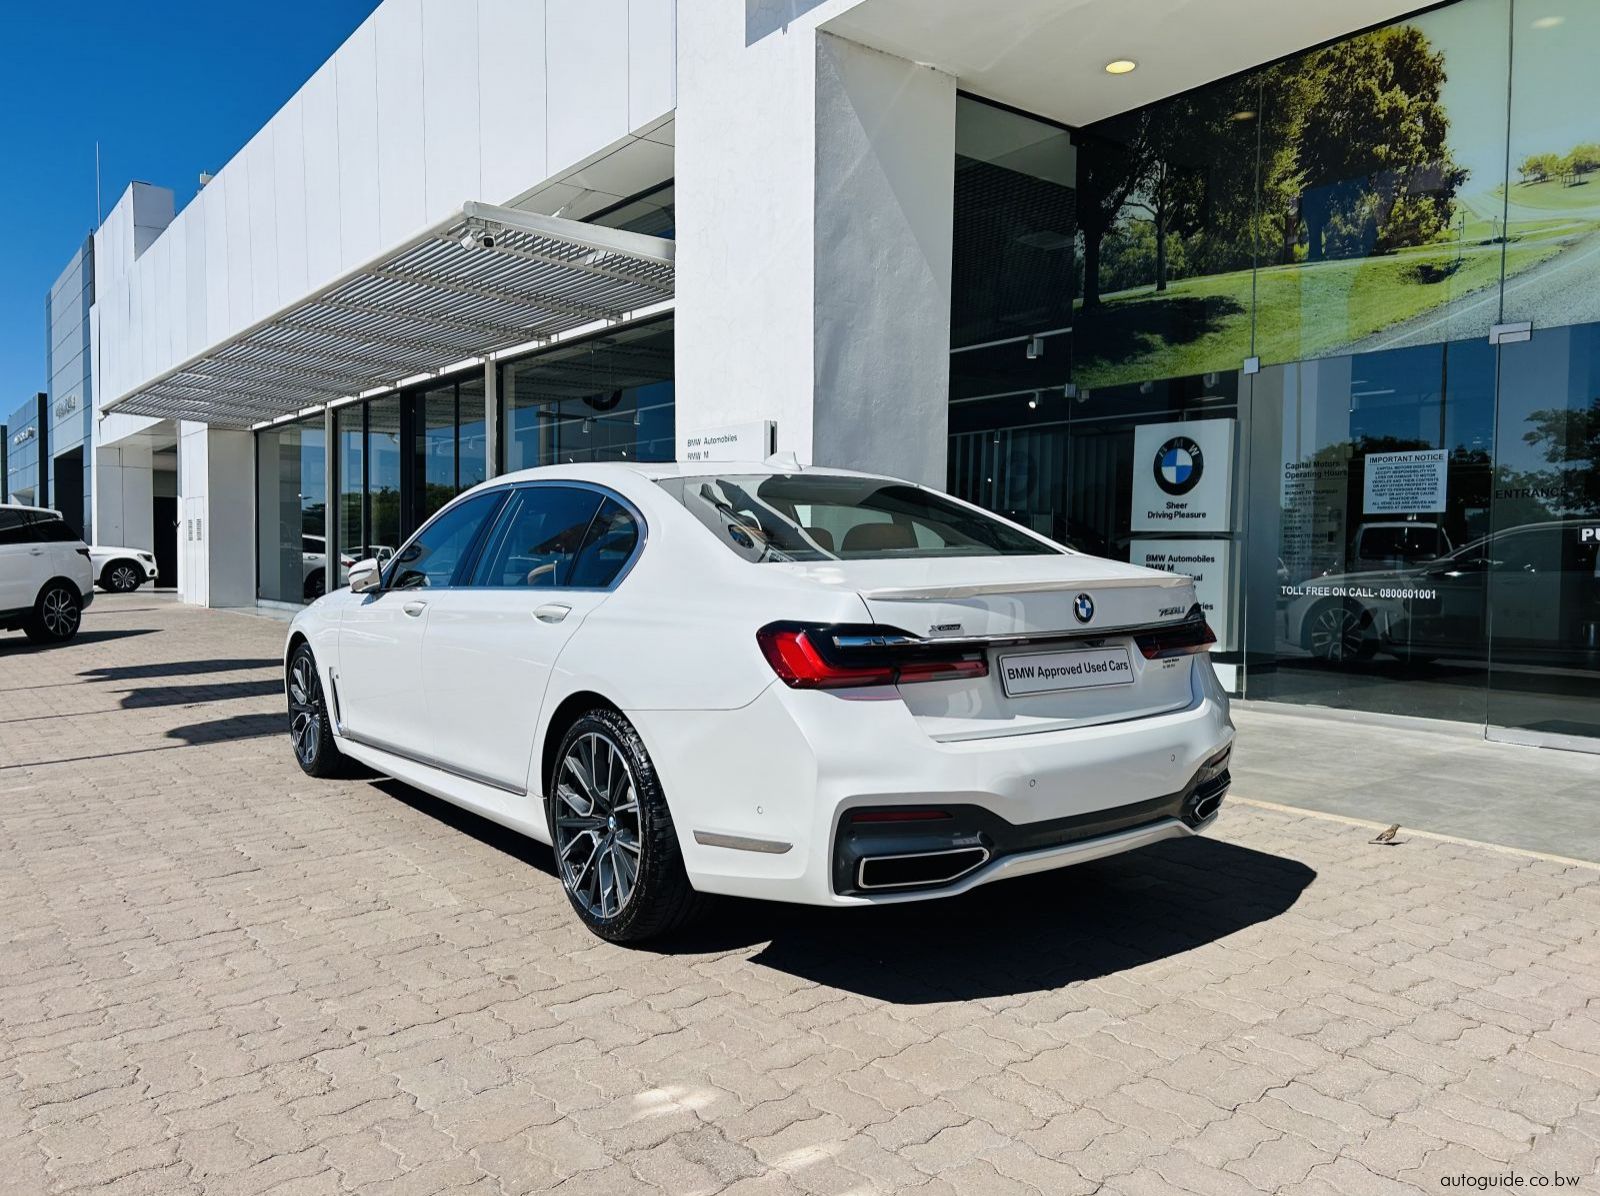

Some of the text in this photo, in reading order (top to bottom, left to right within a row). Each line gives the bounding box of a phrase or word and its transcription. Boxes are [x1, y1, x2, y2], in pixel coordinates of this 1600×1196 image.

[688, 434, 738, 447] BMW Automobiles
[1369, 453, 1444, 464] IMPORTANT NOTICE
[1285, 460, 1341, 470] Capital Motors
[1285, 471, 1322, 479] Operating
[1496, 487, 1567, 499] ENTRANCE
[1166, 502, 1188, 510] Sheer
[1148, 510, 1172, 520] Driving
[1146, 554, 1215, 562] BMW Automobiles
[1168, 564, 1174, 572] M
[1281, 586, 1436, 600] TOLL FREE ON CALL- 0800601001
[1008, 660, 1129, 680] BMW Approved Used Cars
